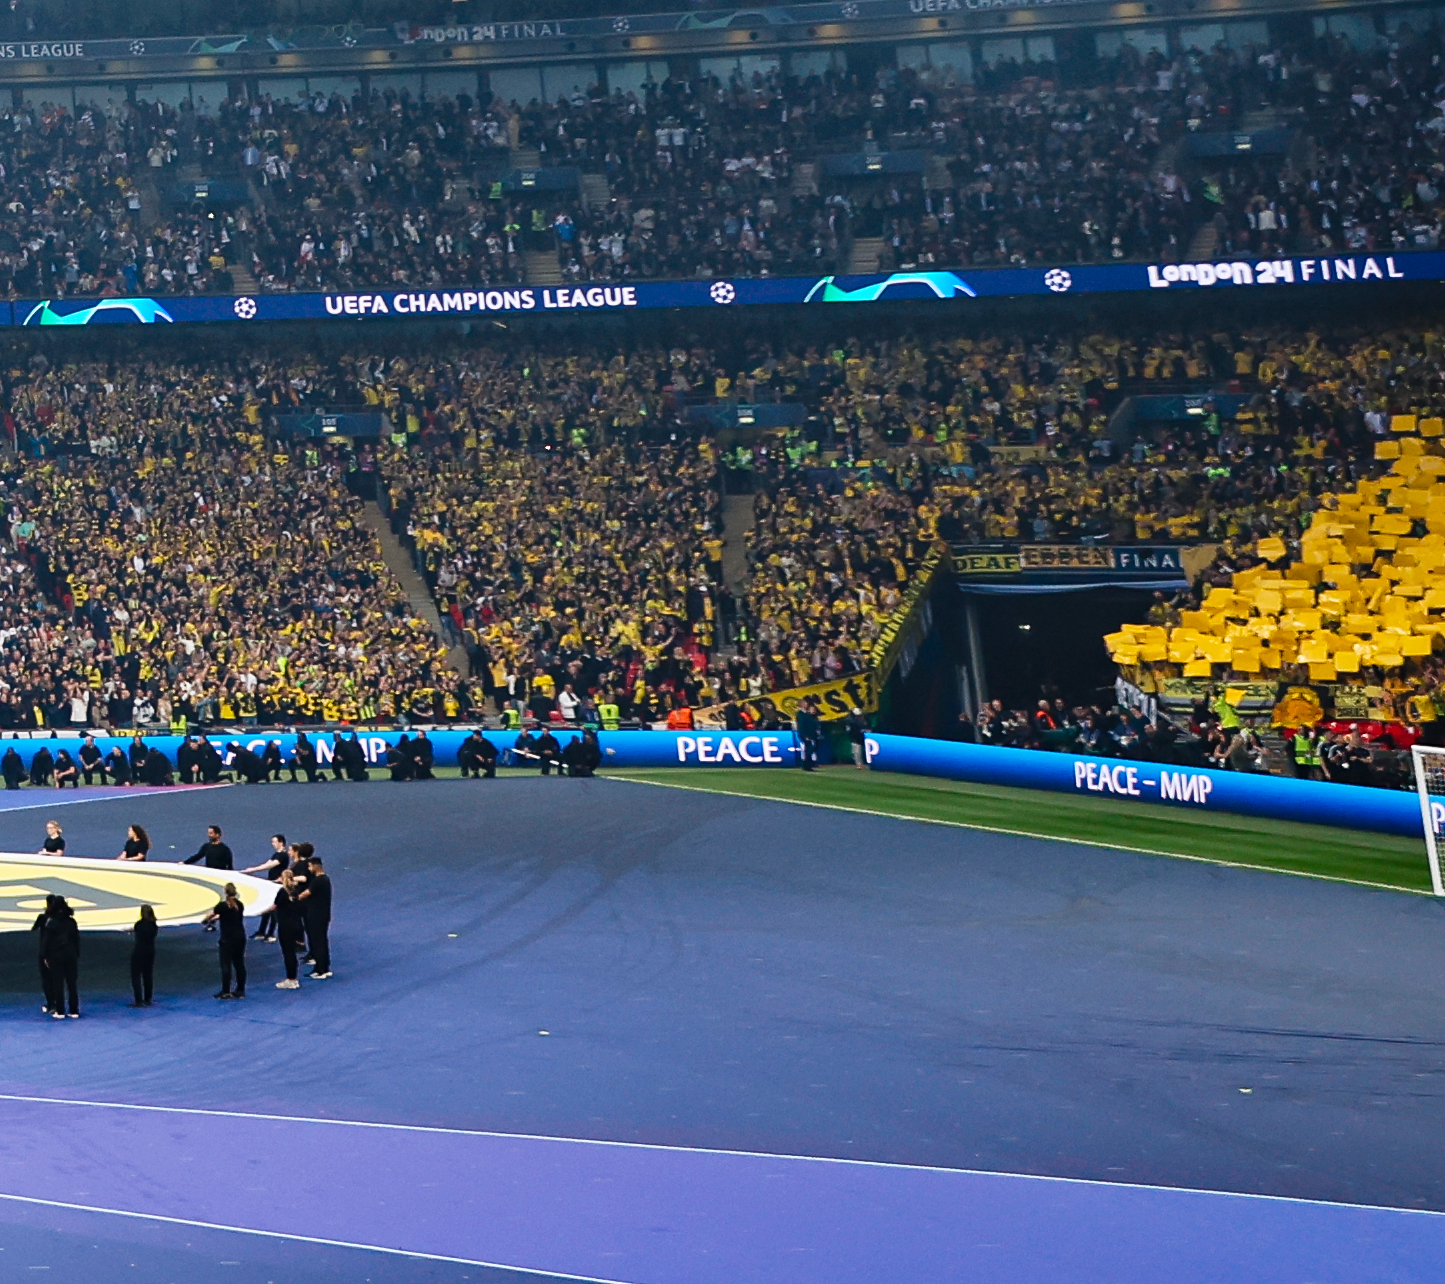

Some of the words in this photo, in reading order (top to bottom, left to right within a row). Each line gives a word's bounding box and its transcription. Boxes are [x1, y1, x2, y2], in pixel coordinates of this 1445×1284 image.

[500, 21, 566, 40] FINAL
[20, 43, 83, 58] LEAGUE
[1255, 261, 1294, 285] 24
[1301, 257, 1404, 281] FINAL
[326, 291, 389, 314] UEFA
[394, 288, 535, 312] CHAMPIONS
[543, 285, 637, 309] LEAGUE
[955, 555, 1019, 572] DEAF
[676, 736, 782, 763] PEACE
[1074, 761, 1138, 797] PEACE
